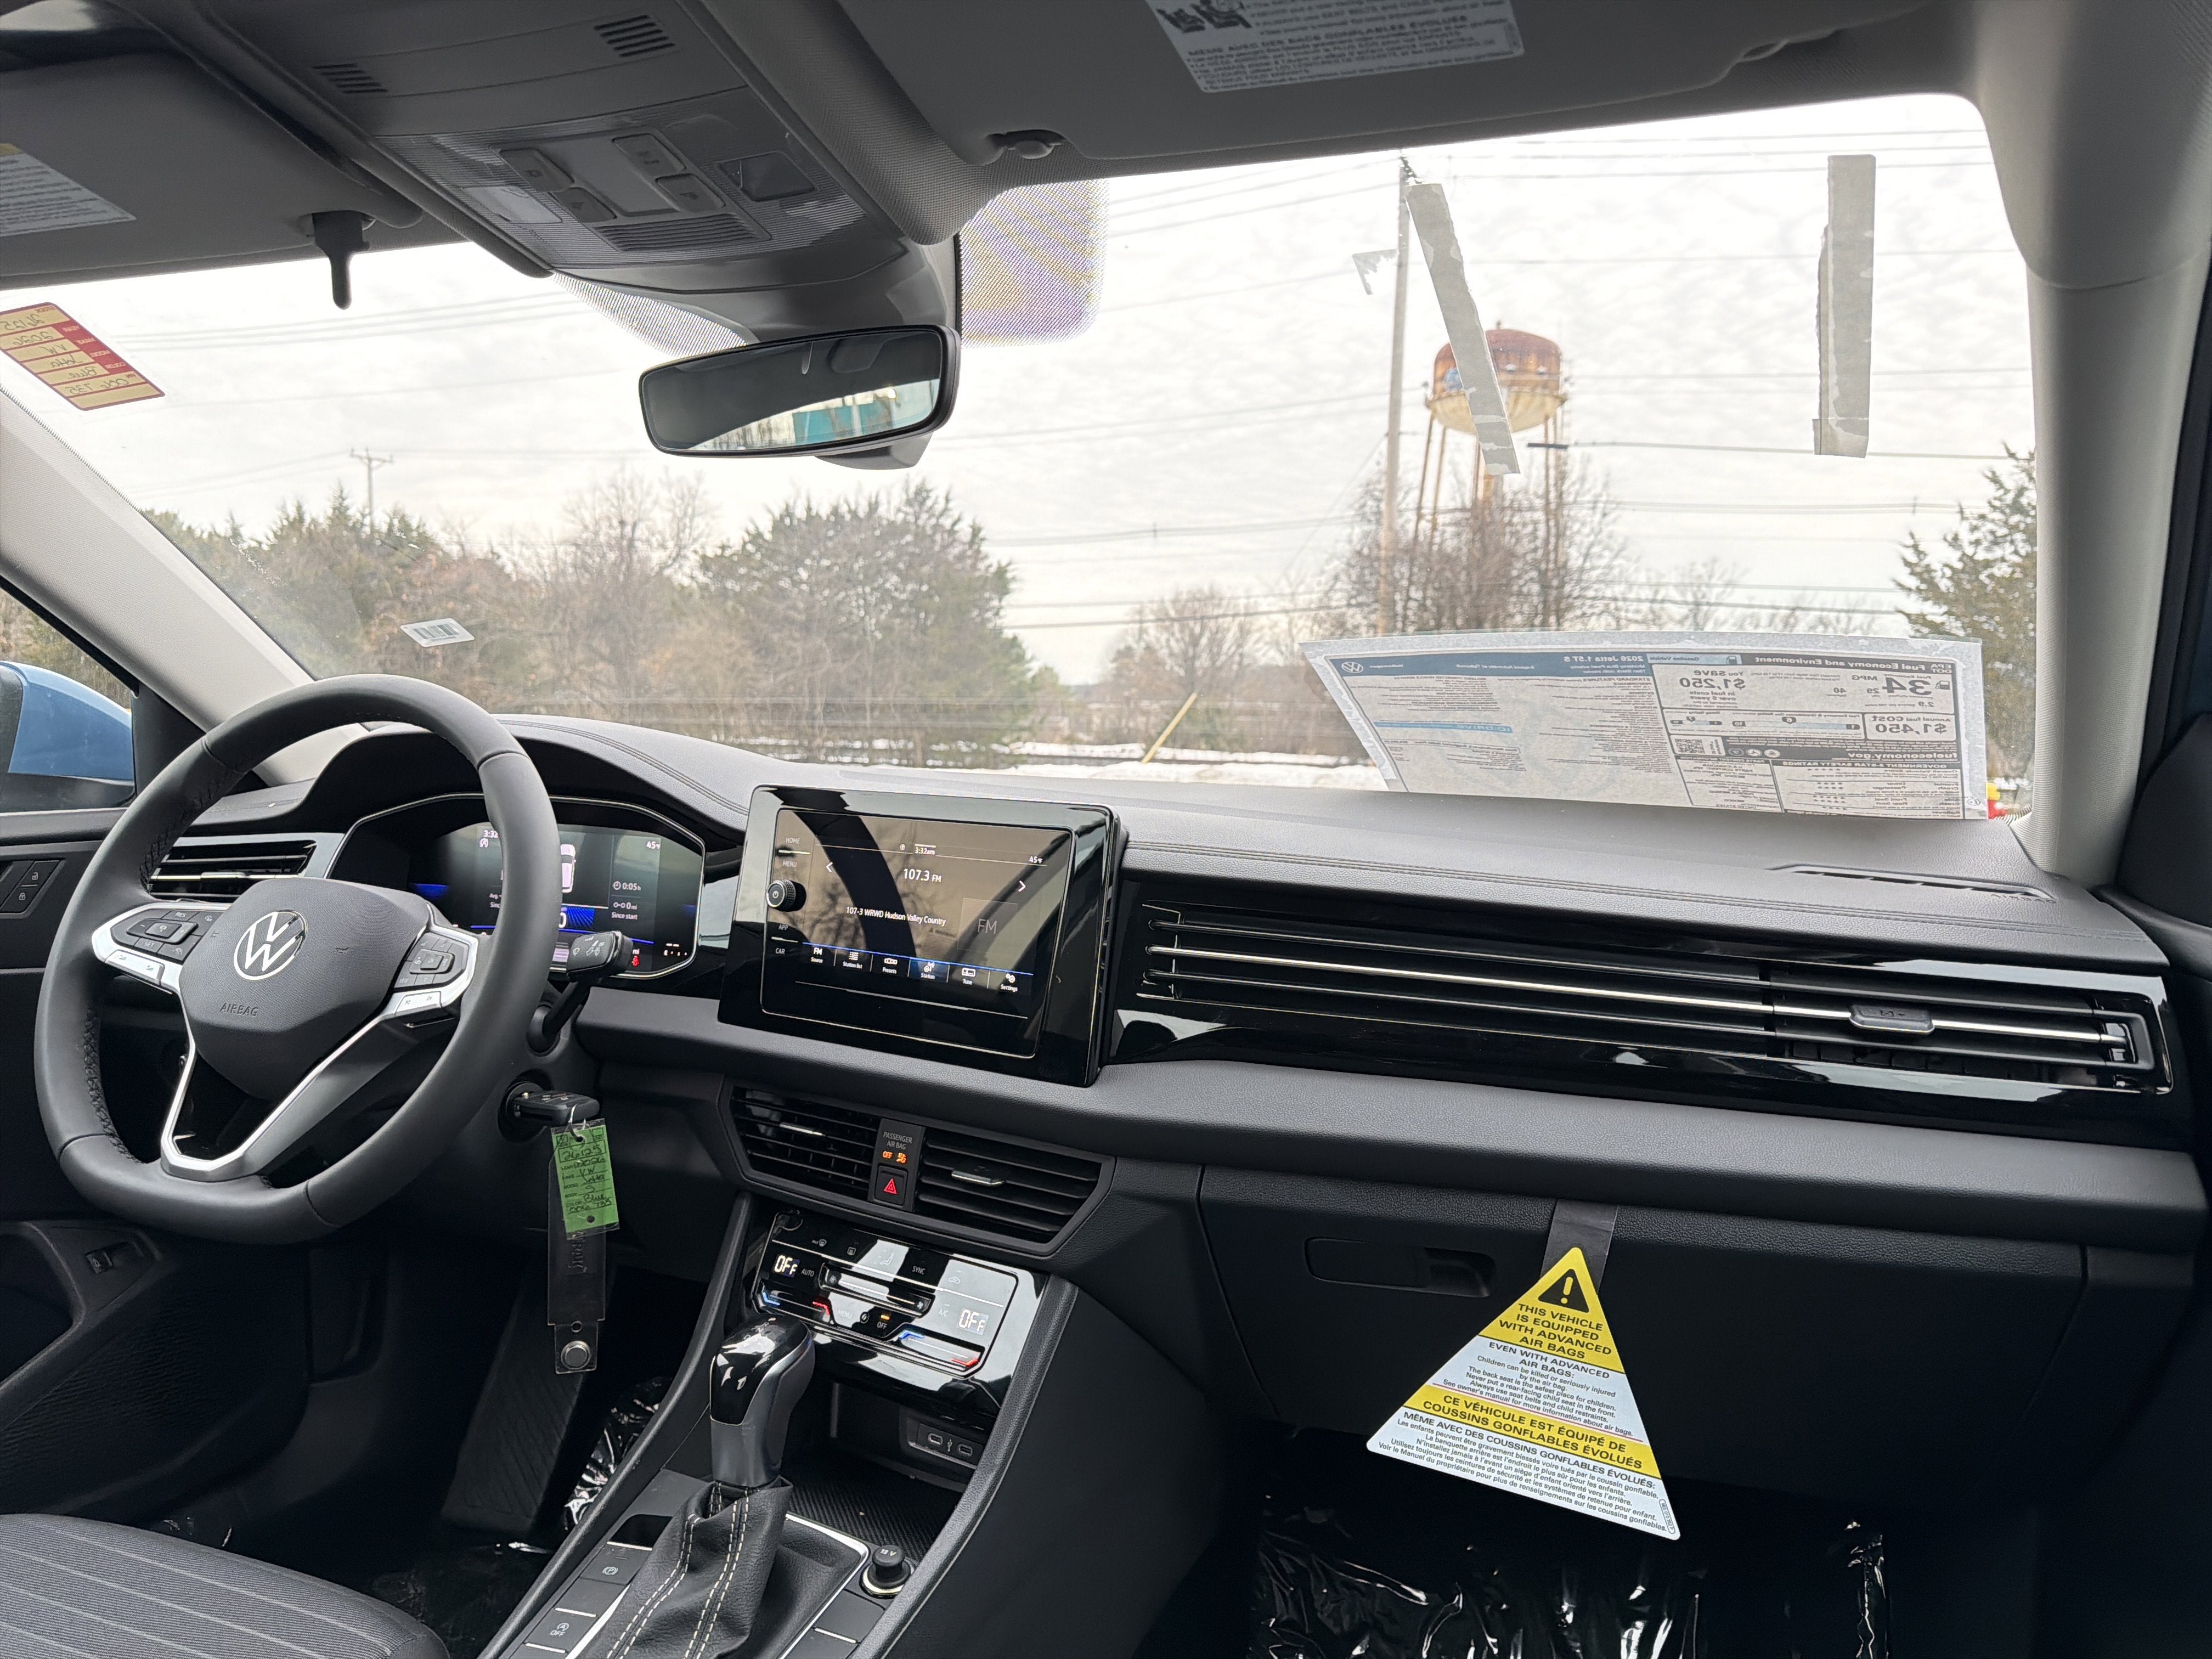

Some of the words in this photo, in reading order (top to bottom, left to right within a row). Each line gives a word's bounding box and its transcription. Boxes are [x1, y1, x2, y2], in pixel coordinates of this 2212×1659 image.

[915, 847, 935, 856] 3:32am
[904, 868, 930, 882] 107.3
[932, 874, 943, 883] FM
[611, 911, 625, 919] Since
[625, 913, 638, 921] start
[846, 906, 864, 916] 107-3
[864, 909, 884, 918] WRWD
[885, 911, 906, 921] Hudson
[907, 913, 923, 924] Valley
[924, 915, 947, 927] Country
[977, 918, 997, 934] FM
[144, 940, 155, 949] SET
[813, 947, 823, 956] FM
[843, 961, 856, 969] Station
[921, 972, 935, 980] Station
[1000, 983, 1019, 993] Settings
[219, 1002, 259, 1017] AIRBAG
[883, 1131, 913, 1144] PASSENGER
[562, 1144, 602, 1160] 26125
[895, 1142, 907, 1150] BAG
[882, 1150, 893, 1159] OFF
[583, 1193, 606, 1204] Blue
[801, 1268, 815, 1278] AUTO
[912, 1266, 926, 1275] SYNC
[938, 1308, 950, 1317] A/C
[1517, 1303, 1547, 1316] THIS
[1550, 1311, 1603, 1331] VEHICLE
[877, 1321, 888, 1329] OFF
[1516, 1313, 1529, 1323] IS
[1532, 1317, 1599, 1340] EQUIPPED
[1499, 1319, 1534, 1335] WITH
[1536, 1330, 1611, 1355] ADVANCED
[1519, 1336, 1543, 1348] AIR
[1547, 1342, 1585, 1359] BAGS
[1489, 1341, 1517, 1354] EVEN
[1520, 1349, 1548, 1362] WITH
[1550, 1358, 1610, 1379] ADVANCED
[1477, 1355, 1505, 1368] Children
[1530, 1369, 1549, 1379] killed
[1559, 1378, 1590, 1391] seriously
[1591, 1386, 1616, 1397] injured
[1519, 1359, 1538, 1368] AIR
[1541, 1364, 1575, 1378] BAGS:
[1469, 1365, 1481, 1374] The
[1482, 1369, 1498, 1379] back
[1534, 1385, 1555, 1395] safest
[1556, 1390, 1575, 1400] place
[1587, 1399, 1616, 1411] children.
[1553, 1382, 1567, 1392] bag.
[1465, 1372, 1486, 1382] Never
[1505, 1384, 1542, 1398] rear-facing
[1543, 1394, 1560, 1402] child
[1598, 1408, 1615, 1418] front.
[1443, 1395, 1460, 1406] CE
[1464, 1400, 1526, 1425] VÉHICULE
[1530, 1419, 1555, 1432] EST
[1557, 1425, 1605, 1447] ÉQUIPÉ
[1608, 1441, 1626, 1453] DE
[1423, 1401, 1489, 1426] COUSSINS
[1493, 1420, 1578, 1451] GONFLABLES
[1582, 1444, 1642, 1469] ÉVOLUÉS
[1403, 1411, 1435, 1426] MÊME
[1436, 1421, 1463, 1434] AVEC
[1464, 1429, 1484, 1440] DES
[1486, 1435, 1537, 1455] COUSSINS
[1539, 1451, 1605, 1474] GONFLABLES
[1607, 1468, 1656, 1489] ÉVOLUÉS:
